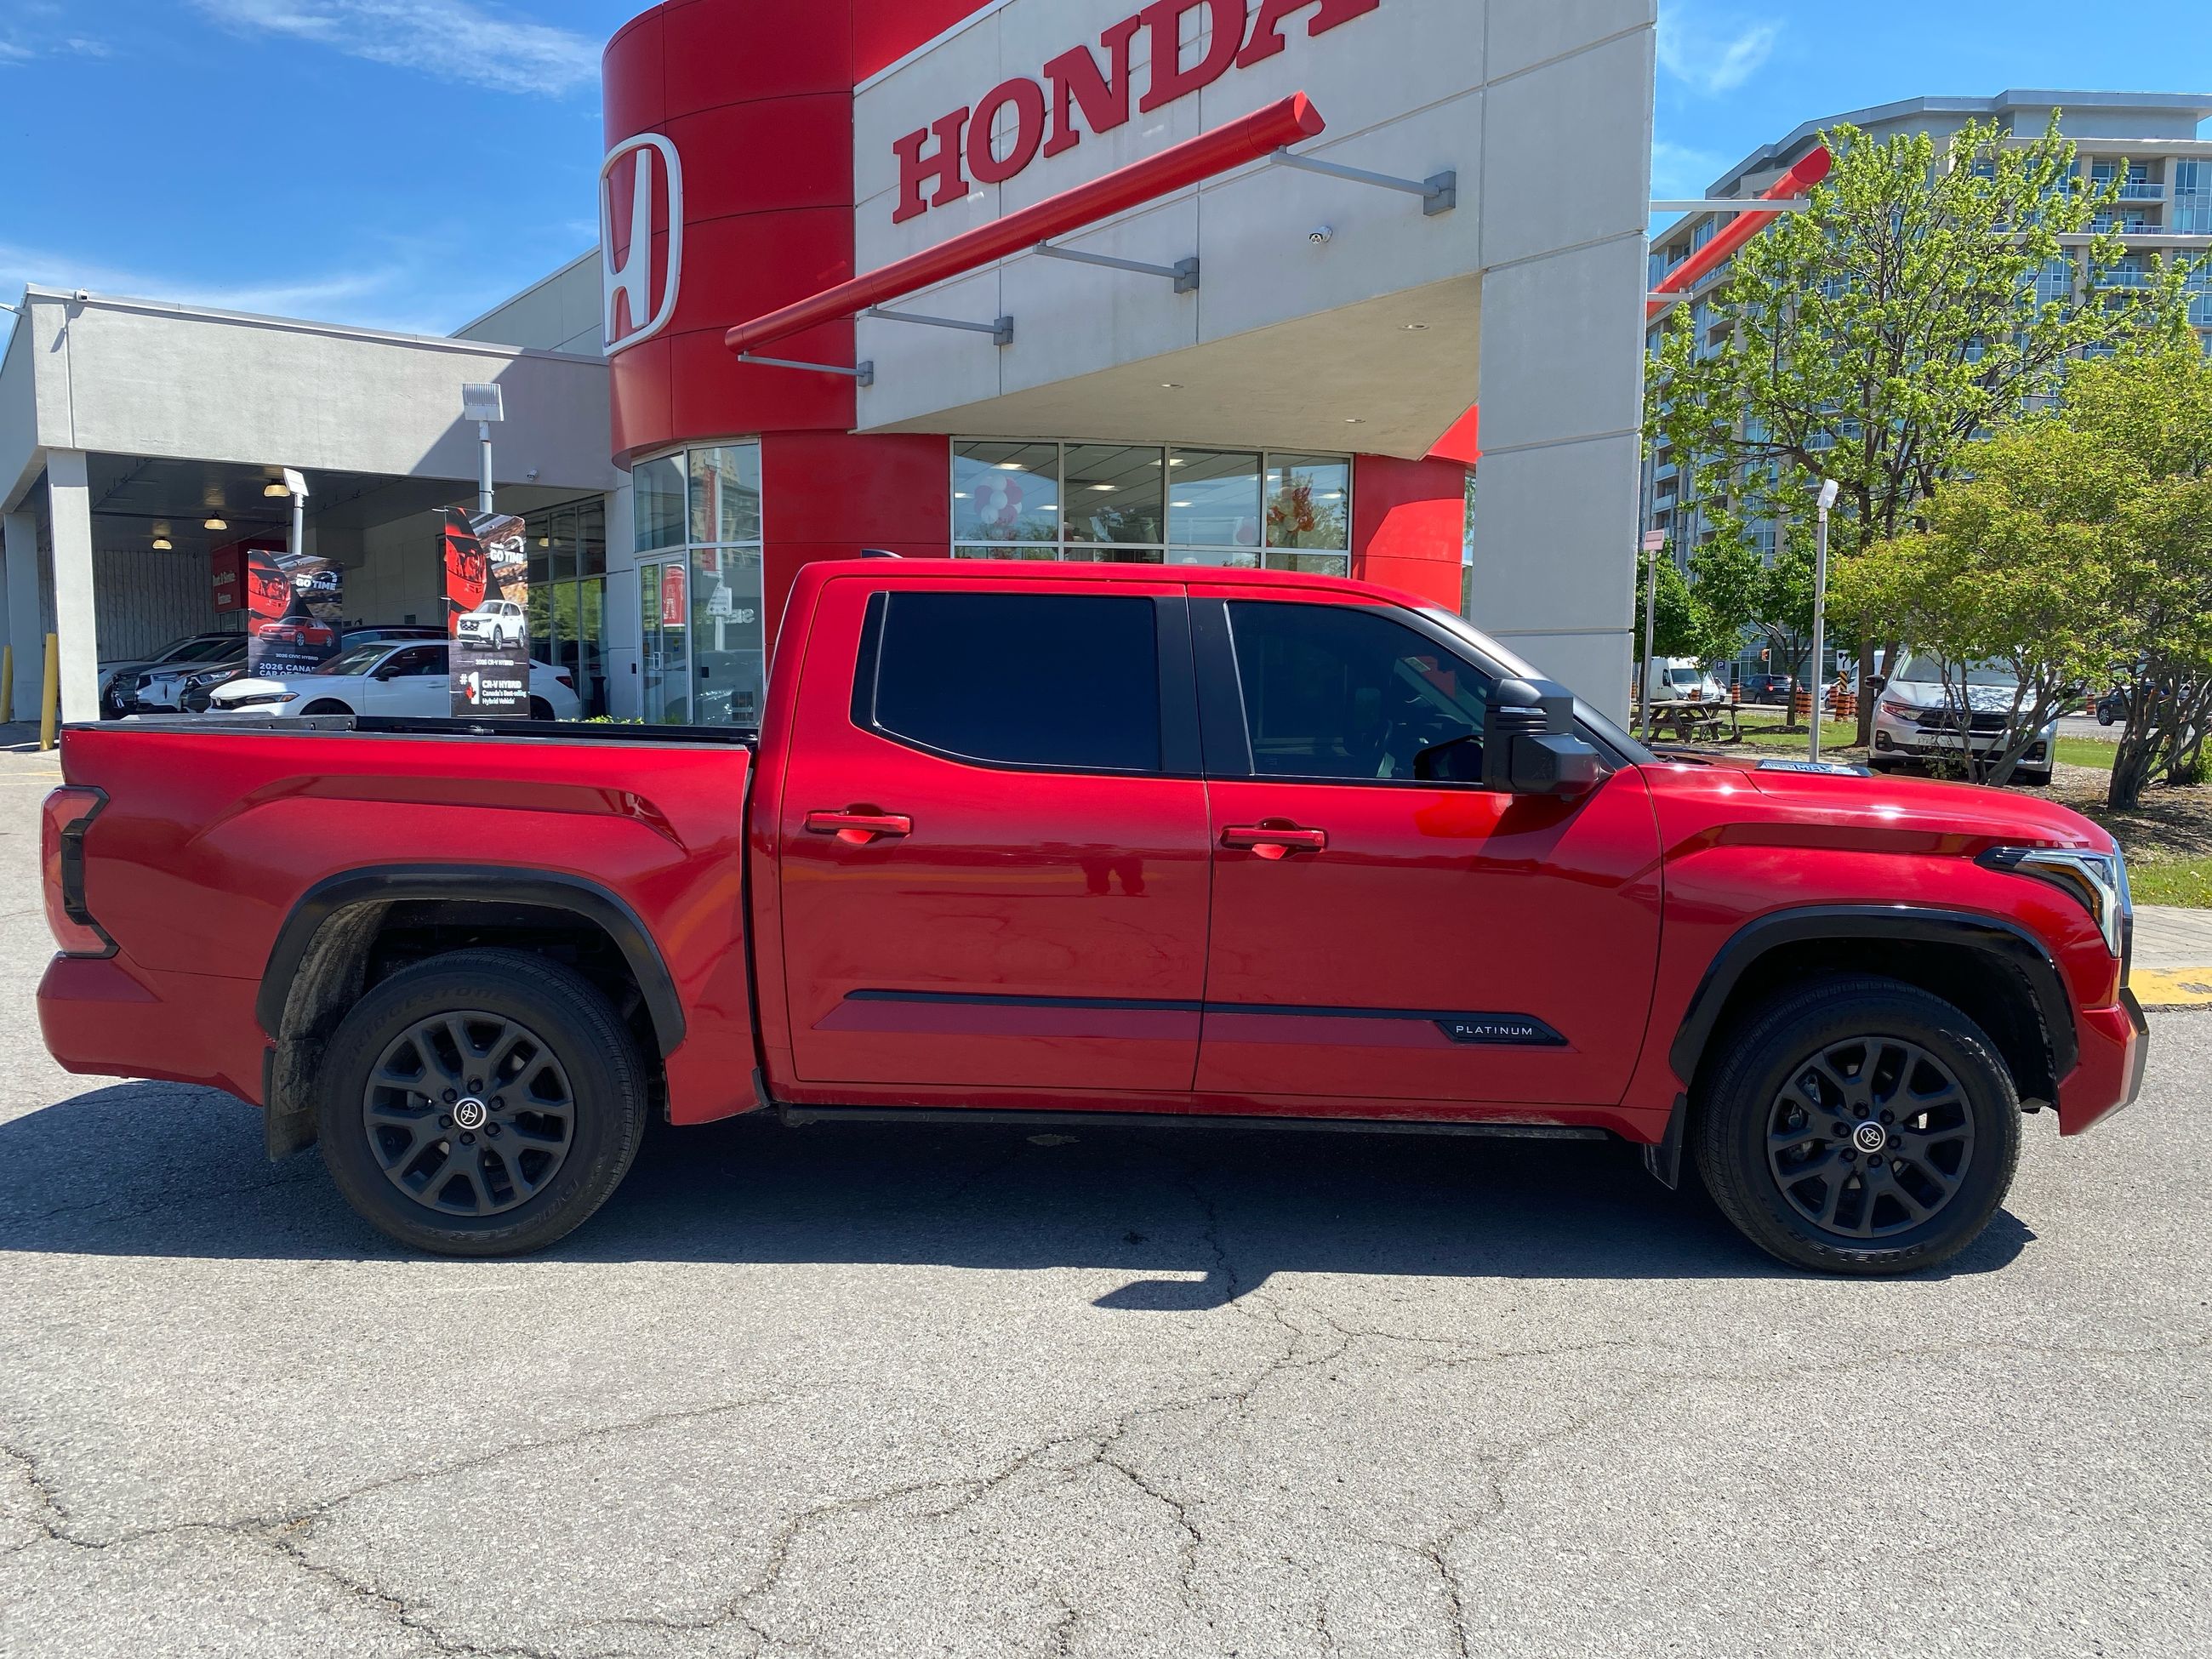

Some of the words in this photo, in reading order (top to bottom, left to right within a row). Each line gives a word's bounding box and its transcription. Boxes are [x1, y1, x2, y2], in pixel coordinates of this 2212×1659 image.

[490, 549, 505, 562] GO
[505, 551, 524, 564] TIME
[295, 579, 311, 587] GO
[312, 580, 337, 590] TIME
[1456, 1025, 1532, 1035] PLATINUM
[1787, 1230, 1927, 1265] DUELER
